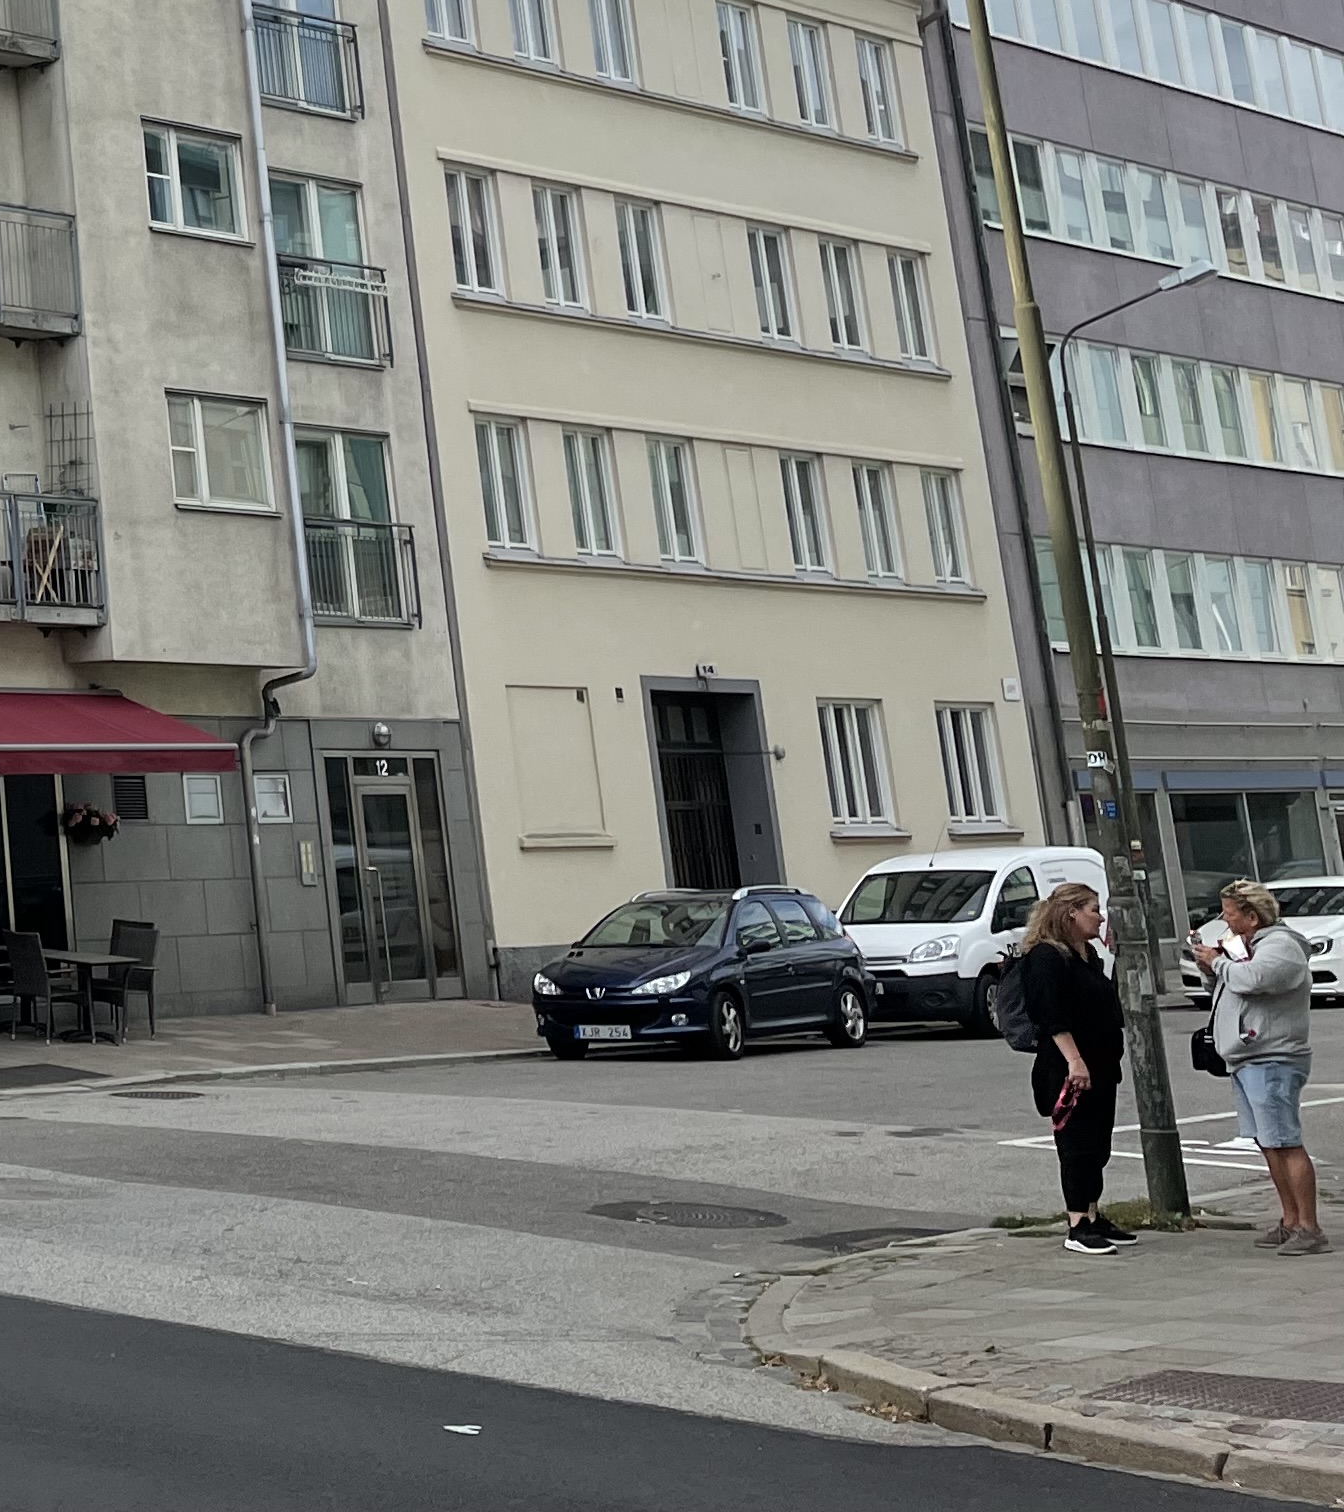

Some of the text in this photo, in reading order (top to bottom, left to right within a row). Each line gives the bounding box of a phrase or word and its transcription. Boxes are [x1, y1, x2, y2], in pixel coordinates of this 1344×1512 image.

[702, 665, 714, 674] 14
[376, 759, 389, 776] 12
[607, 1027, 629, 1037] 254
